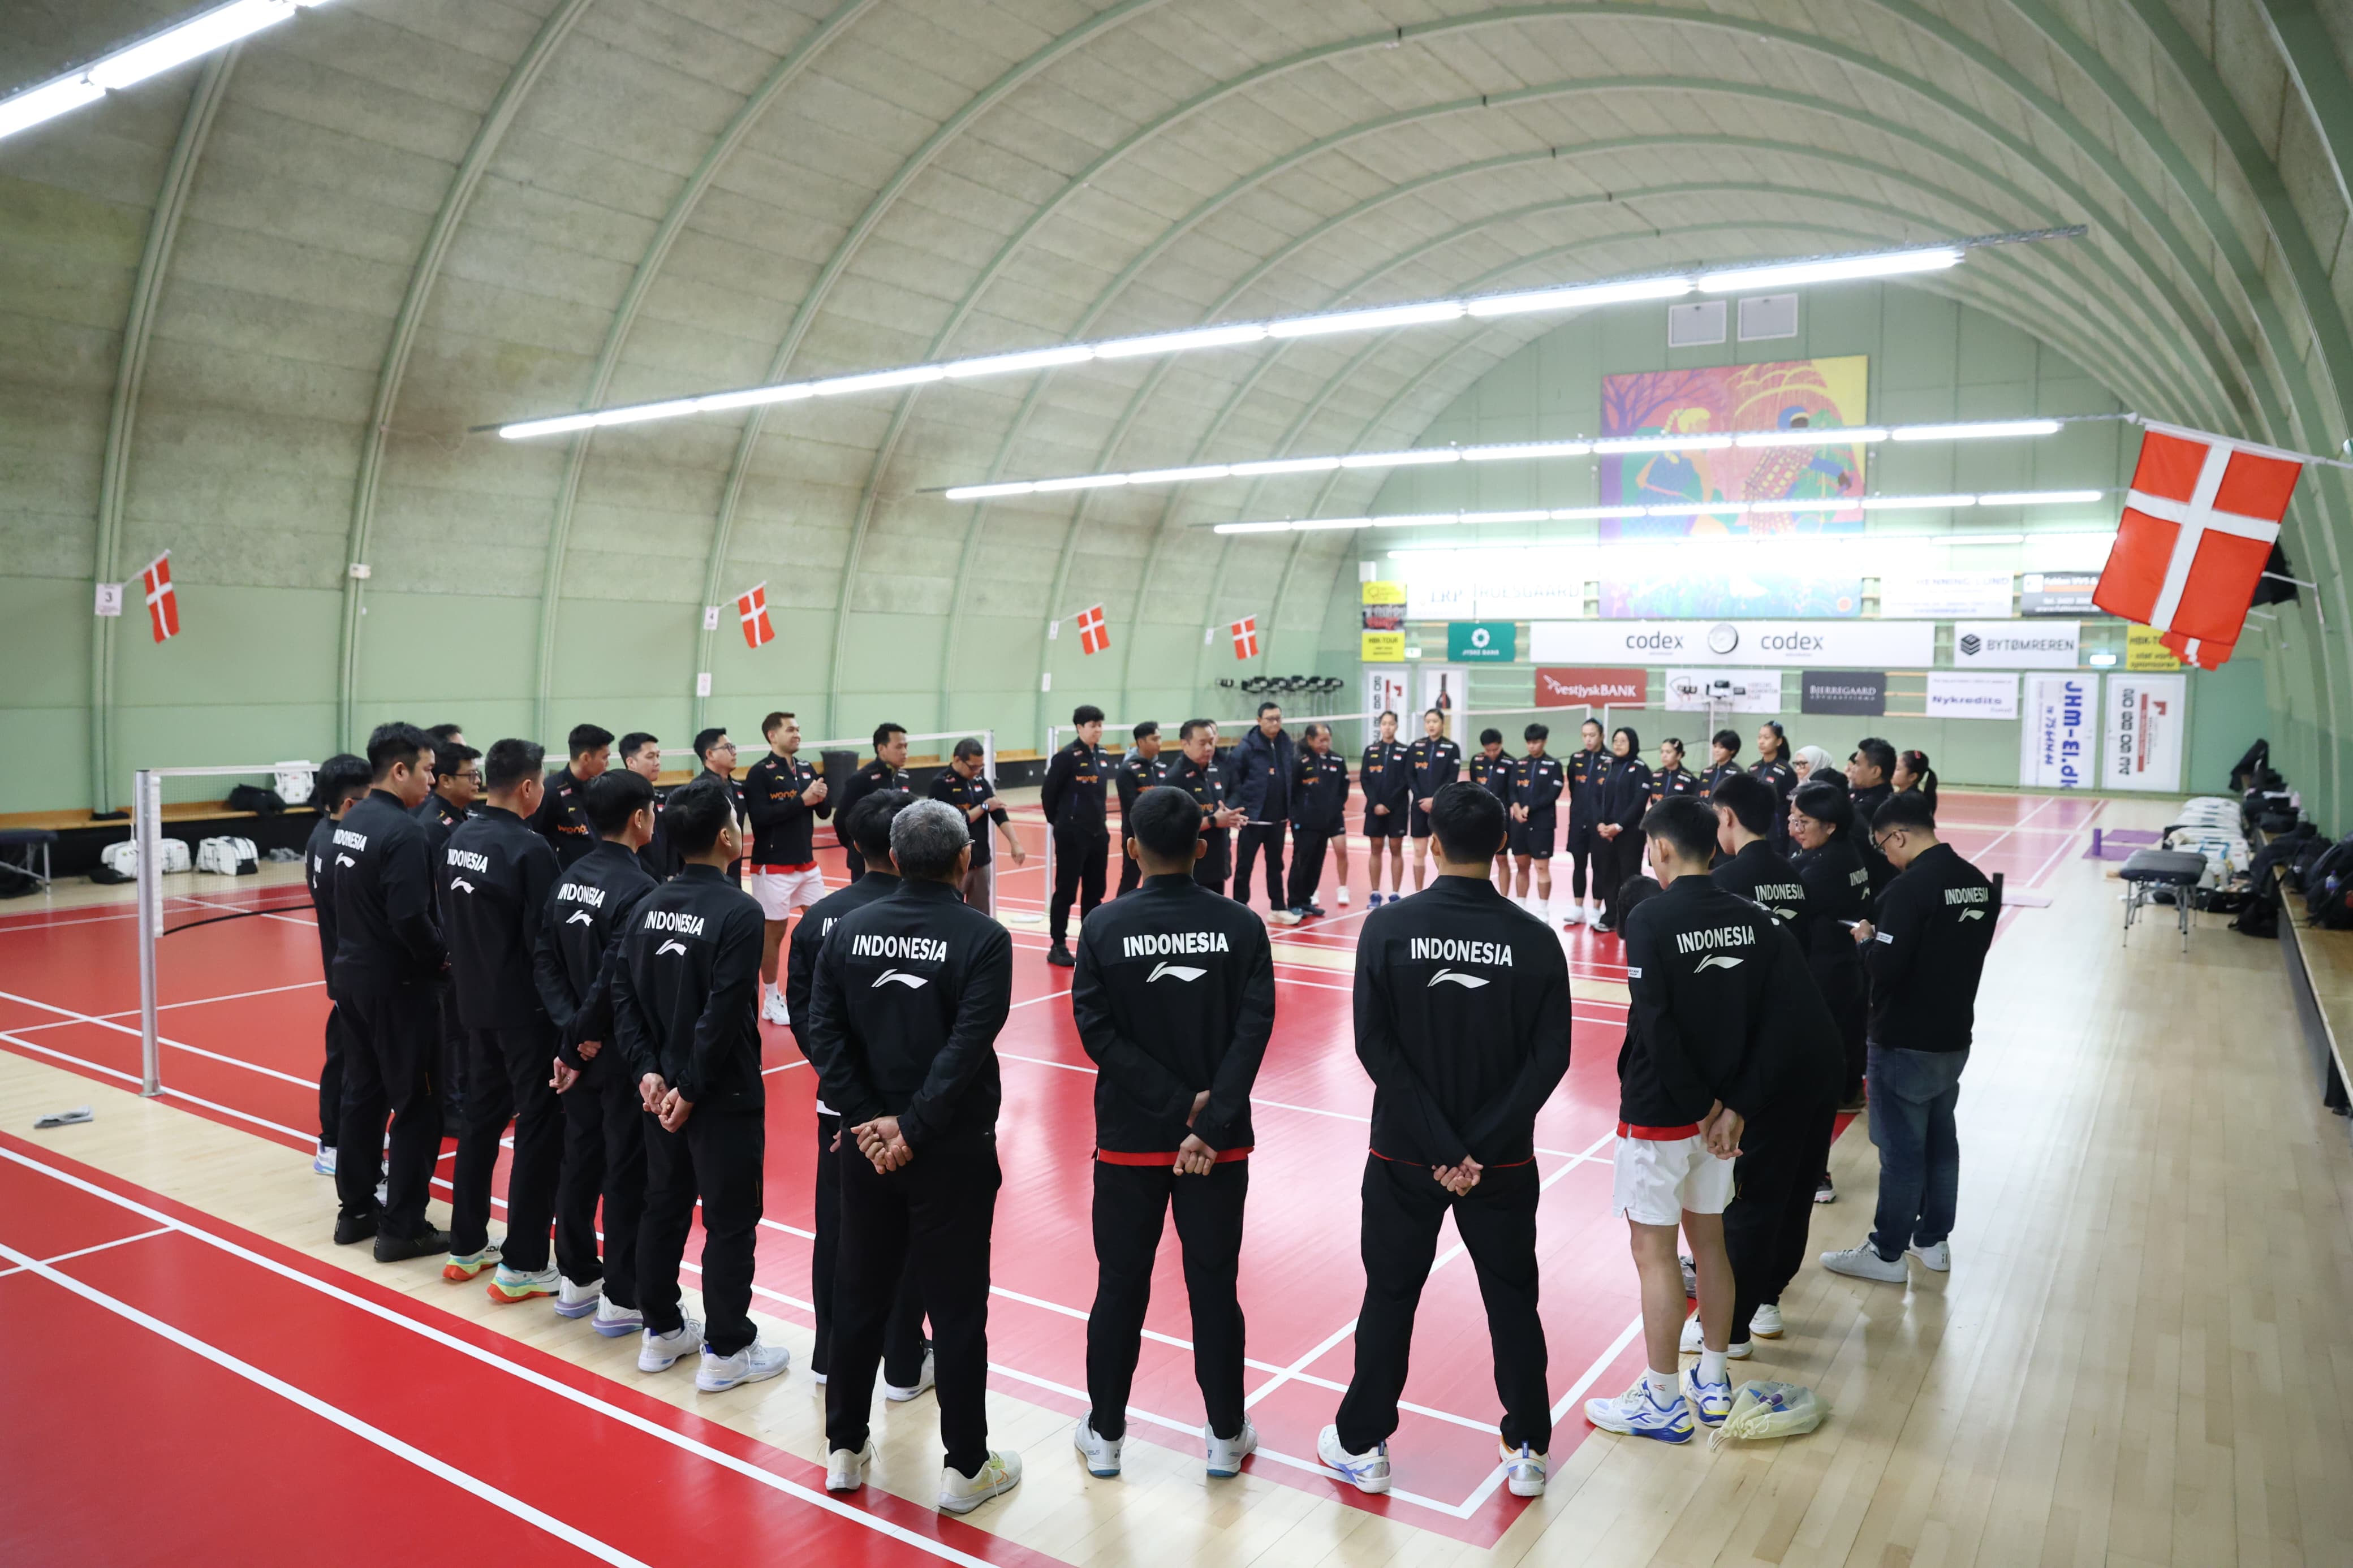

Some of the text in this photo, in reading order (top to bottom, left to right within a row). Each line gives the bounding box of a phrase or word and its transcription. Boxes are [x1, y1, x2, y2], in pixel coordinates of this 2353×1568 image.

[105, 591, 113, 603] 3
[1626, 631, 1683, 649] codex
[1761, 631, 1824, 650] codex
[1988, 639, 2074, 651] BYTØMREREN
[1555, 684, 1636, 698] vestjyskBANK
[1755, 884, 1805, 901] INDONESIA
[1945, 887, 1989, 905] INDONESIA
[644, 910, 705, 936] INDONESIA
[852, 935, 947, 962] INDONESIA
[1123, 932, 1229, 957] INDONESIA
[1677, 926, 1755, 953] INDONESIA
[1411, 938, 1513, 967] INDONESIA
